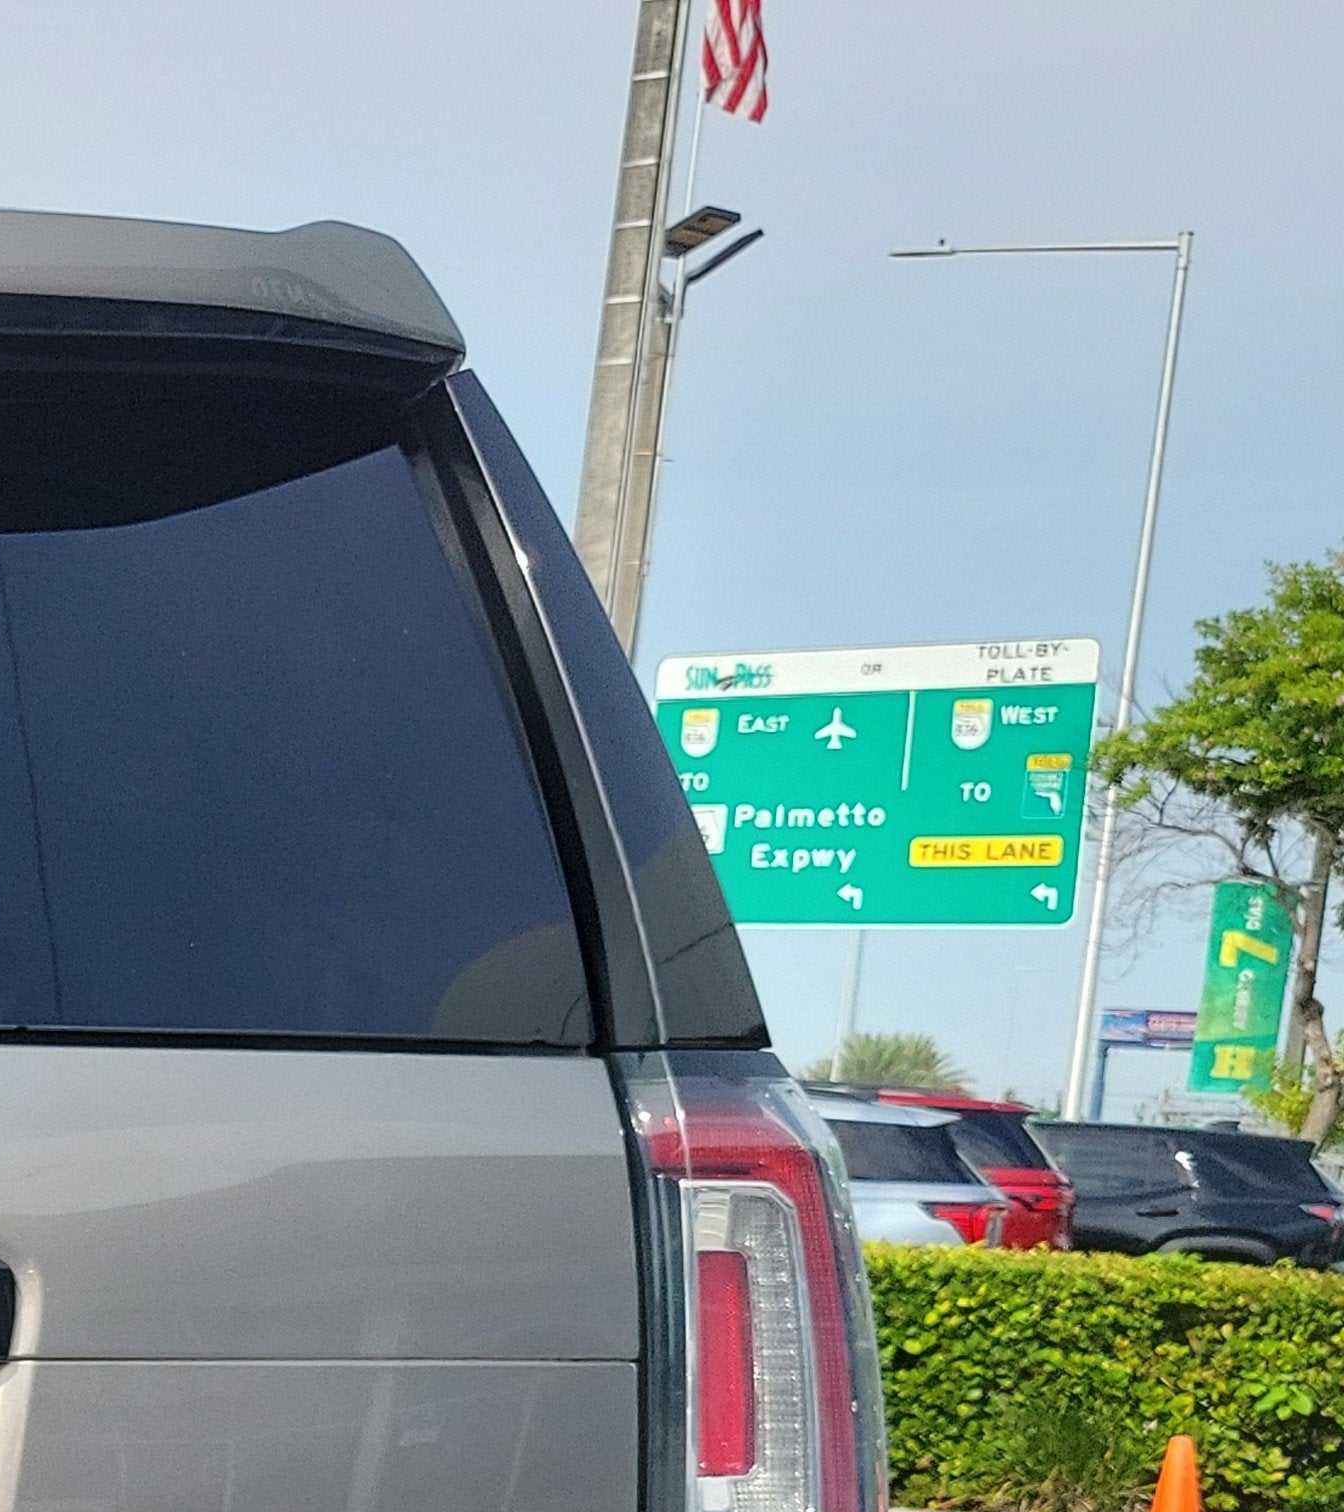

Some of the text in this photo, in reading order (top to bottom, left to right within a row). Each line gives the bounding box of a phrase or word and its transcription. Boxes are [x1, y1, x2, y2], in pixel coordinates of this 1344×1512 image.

[986, 667, 1052, 682] PLATE
[737, 714, 790, 733] EAST
[1000, 705, 1059, 725] WEST
[678, 772, 709, 791] TO
[959, 782, 991, 802] TO
[734, 803, 886, 828] Palmetto
[751, 843, 856, 873] Expwy
[919, 841, 1053, 861] THIS LANE
[1219, 929, 1279, 967] 7
